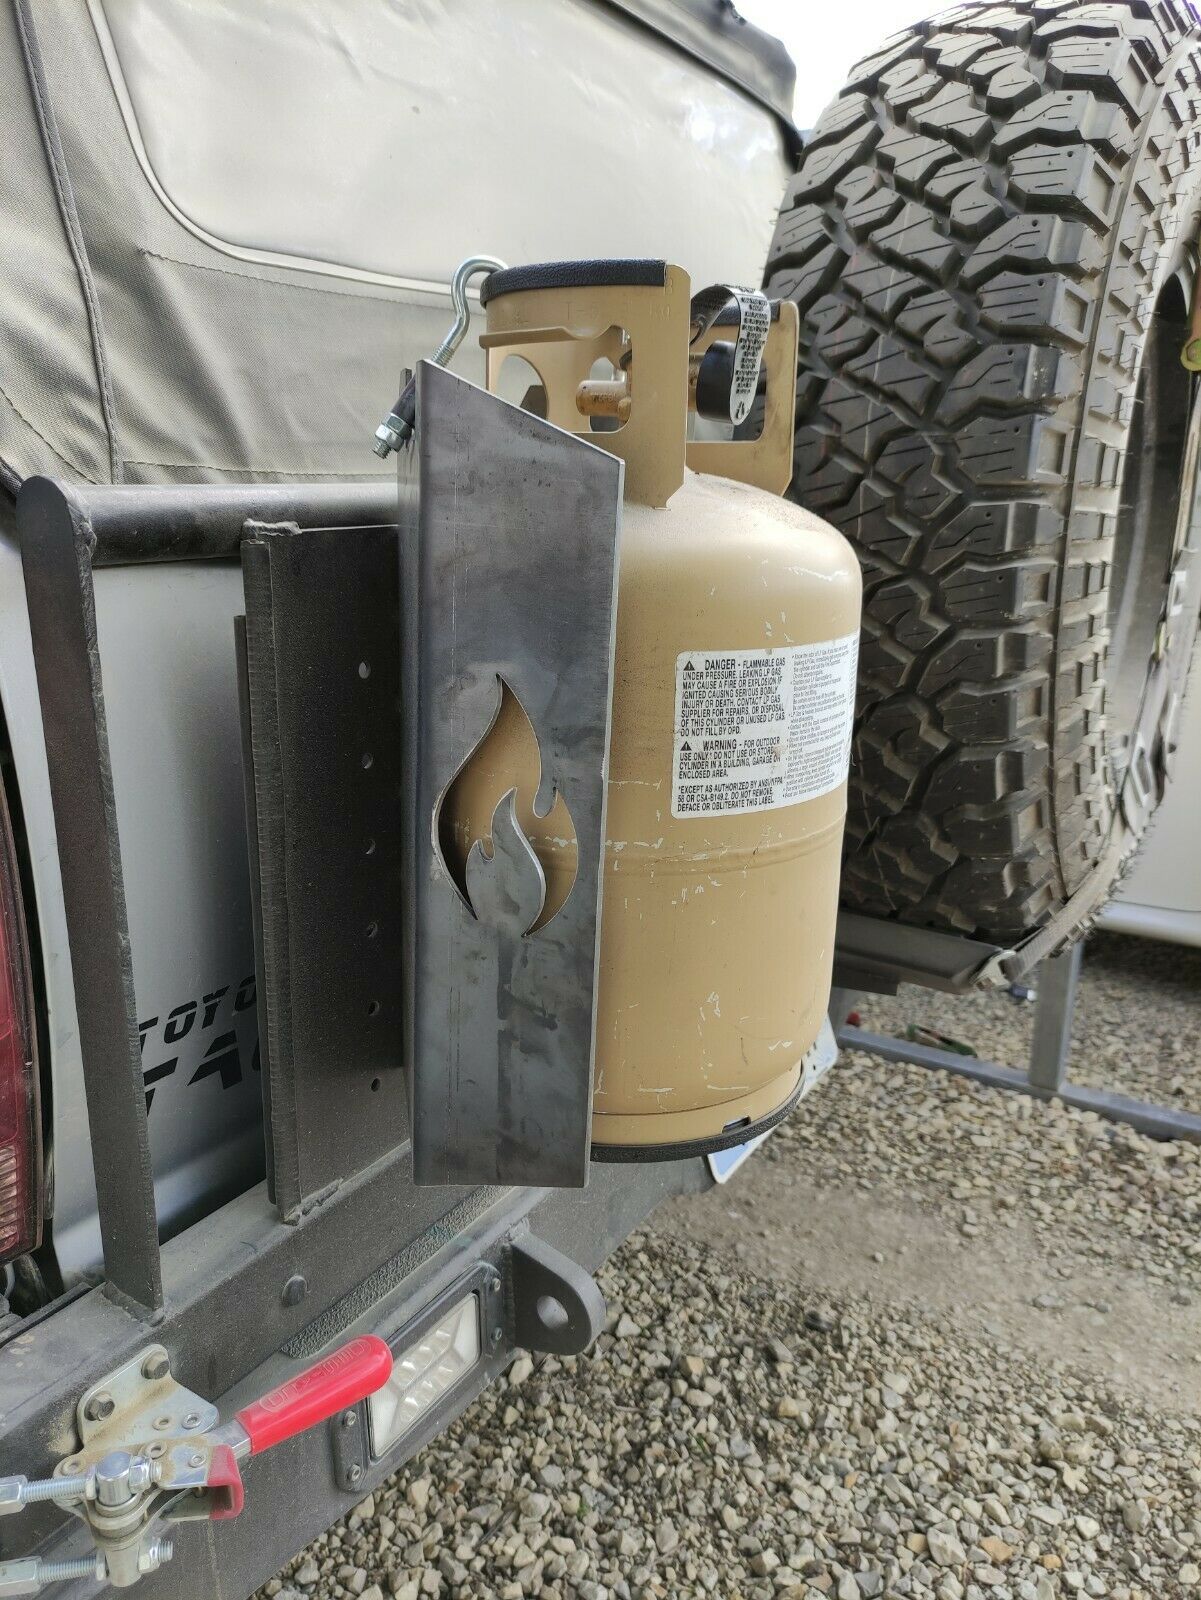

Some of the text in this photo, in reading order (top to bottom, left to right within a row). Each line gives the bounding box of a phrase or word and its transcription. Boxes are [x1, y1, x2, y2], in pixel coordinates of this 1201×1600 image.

[705, 659, 736, 670] DANGER
[743, 658, 774, 668] FLAMMABLE
[776, 657, 786, 666] GAS
[683, 672, 704, 680] UNDER
[740, 669, 762, 678] LEAKING
[771, 667, 781, 676] GAS
[683, 681, 694, 689] MAY
[697, 680, 716, 689] CAUSE
[748, 677, 776, 687] EXPLOSION
[682, 691, 706, 699] IGNITED
[708, 690, 733, 698] CAUSING
[735, 688, 758, 697] SERIOUS
[681, 700, 703, 708] INJURY
[737, 697, 762, 706] CONTACT
[771, 695, 780, 703] GAS
[681, 710, 710, 718] SUPPLIER
[712, 709, 723, 717] FOR
[691, 719, 704, 727] THIS
[706, 717, 734, 726] CYLINDER
[692, 728, 703, 736] NOT
[703, 739, 737, 751] WARNING
[744, 740, 754, 748] FOR
[680, 753, 691, 761] USE
[723, 750, 735, 759] NOT
[737, 750, 747, 758] USE
[679, 762, 708, 770] CYLINDER
[679, 770, 710, 780] ENCLOSED
[715, 782, 749, 792] AUTHORIZED
[740, 790, 751, 798] NOT
[678, 802, 700, 812] DEFACE
[712, 799, 744, 810] OBLITERATE
[746, 798, 758, 807] THIS
[143, 1030, 261, 1117] TA
